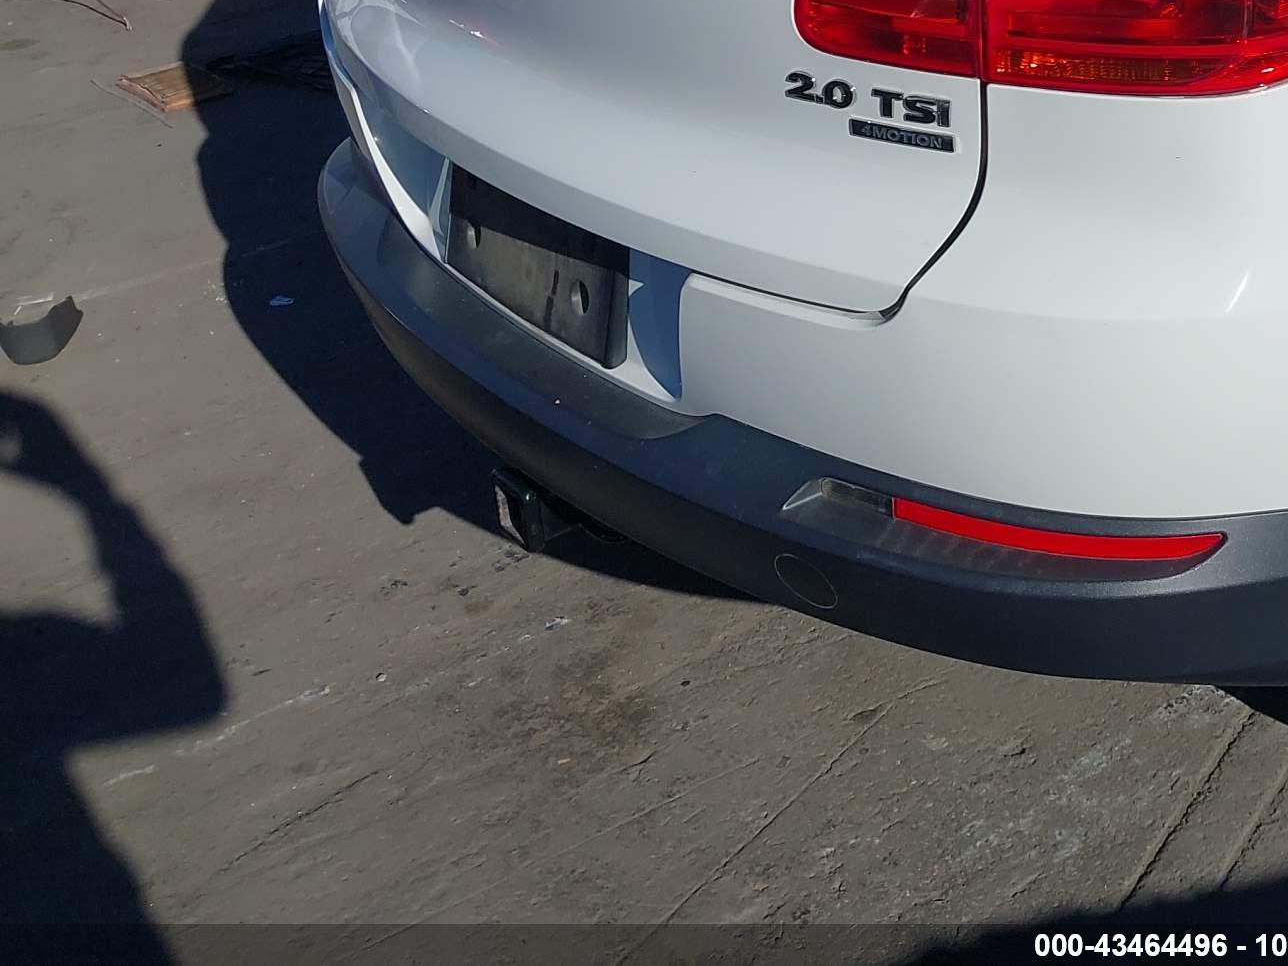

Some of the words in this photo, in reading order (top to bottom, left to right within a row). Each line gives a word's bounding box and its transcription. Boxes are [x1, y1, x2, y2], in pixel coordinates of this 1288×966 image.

[784, 71, 856, 109] 2.0
[870, 87, 951, 128] TSI
[860, 123, 944, 150] 4MOTION
